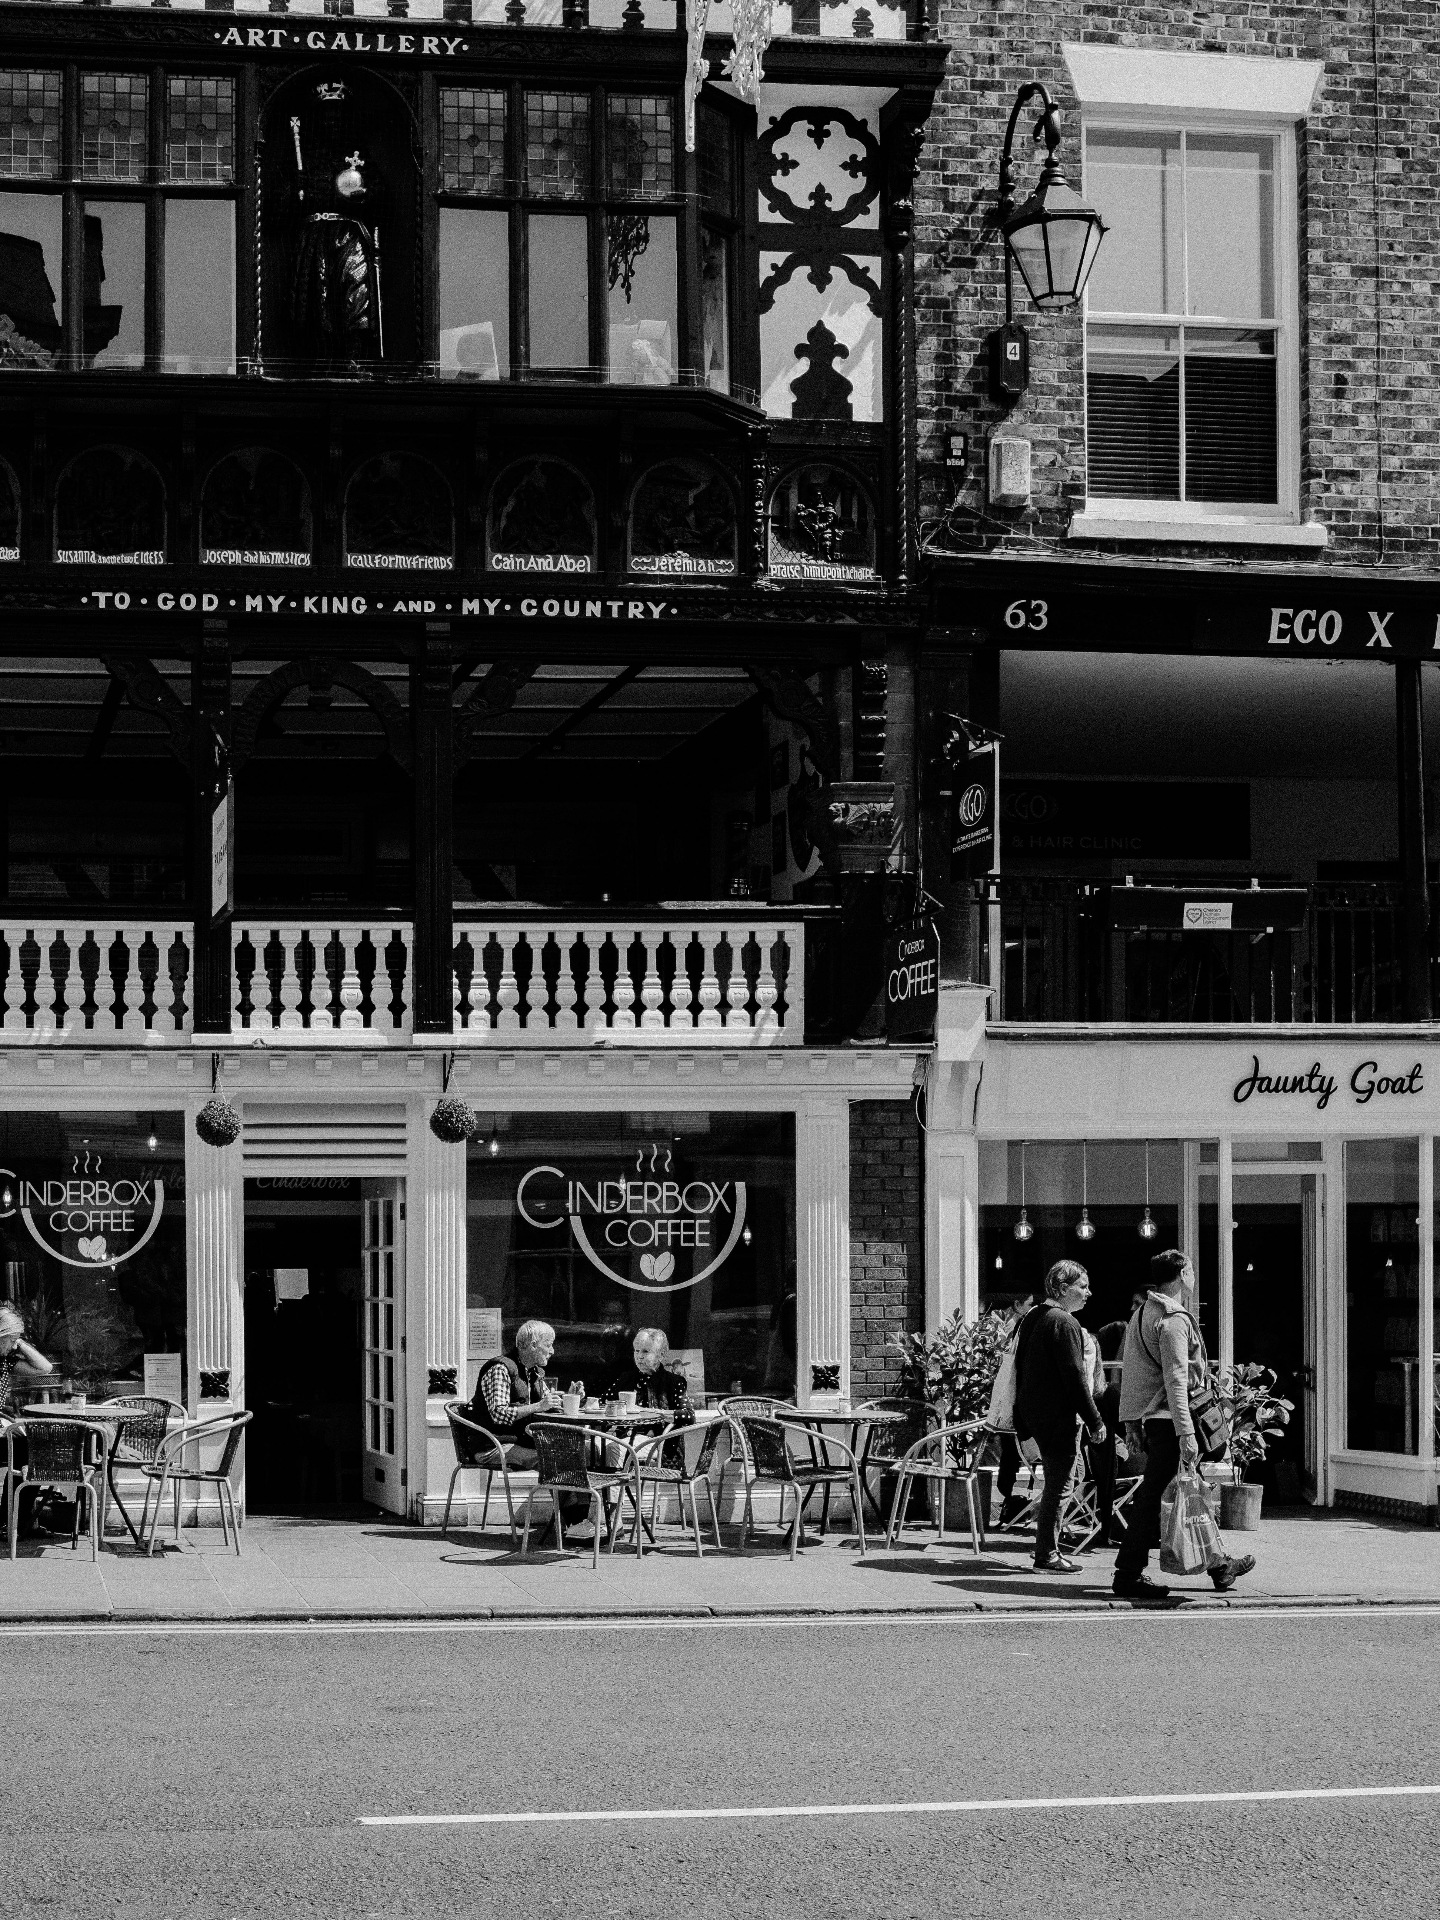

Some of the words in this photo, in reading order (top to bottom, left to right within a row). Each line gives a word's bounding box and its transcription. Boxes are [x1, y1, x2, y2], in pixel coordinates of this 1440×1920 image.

[221, 28, 288, 48] ART
[306, 32, 463, 54] GALLERY
[1009, 344, 1018, 358] 4
[492, 554, 525, 570] Cain
[554, 555, 591, 573] Abel
[92, 592, 131, 609] TO
[158, 593, 218, 611] GOD
[246, 595, 286, 612] MY
[304, 597, 368, 614] KING
[393, 601, 435, 613] AND
[462, 599, 502, 616] MY
[521, 599, 667, 618] COUNTRY
[1004, 599, 1048, 630] 63
[1268, 608, 1343, 645] EGO
[1366, 611, 1394, 648] X
[963, 788, 982, 822] EGO
[1030, 835, 1074, 849] HAIR
[1079, 836, 1143, 850] CLINIC
[898, 939, 925, 962] CINDERBOX
[888, 958, 936, 1003] COFFEE
[1233, 1055, 1338, 1109] Jaunty
[1351, 1061, 1424, 1104] Goat
[516, 1165, 731, 1229] CINDERBOX
[49, 1209, 135, 1232] COFFEE
[605, 1219, 710, 1247] COFFEE
